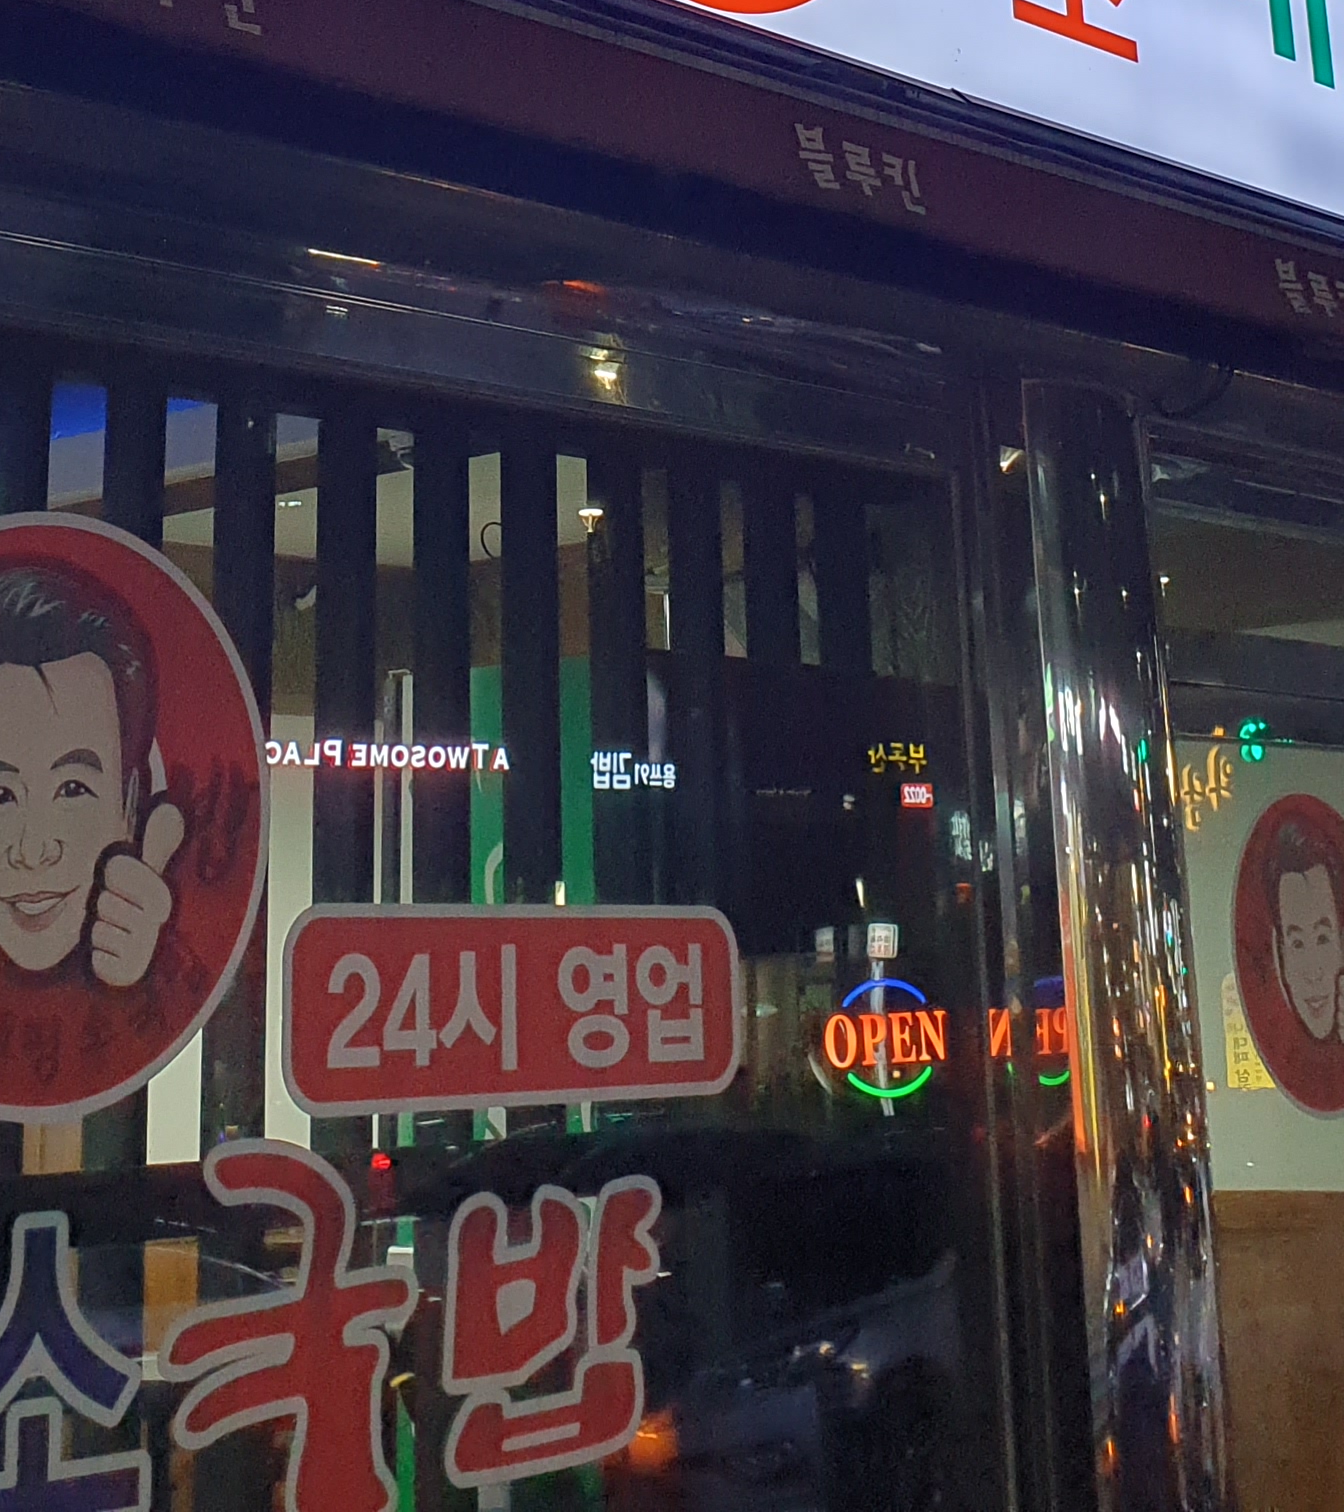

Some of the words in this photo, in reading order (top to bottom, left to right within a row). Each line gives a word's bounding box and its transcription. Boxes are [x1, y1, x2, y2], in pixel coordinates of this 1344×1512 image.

[794, 122, 926, 216] 블루킨
[326, 944, 518, 1071] 24시
[557, 944, 705, 1069] 영업
[824, 1010, 947, 1069] OPEN
